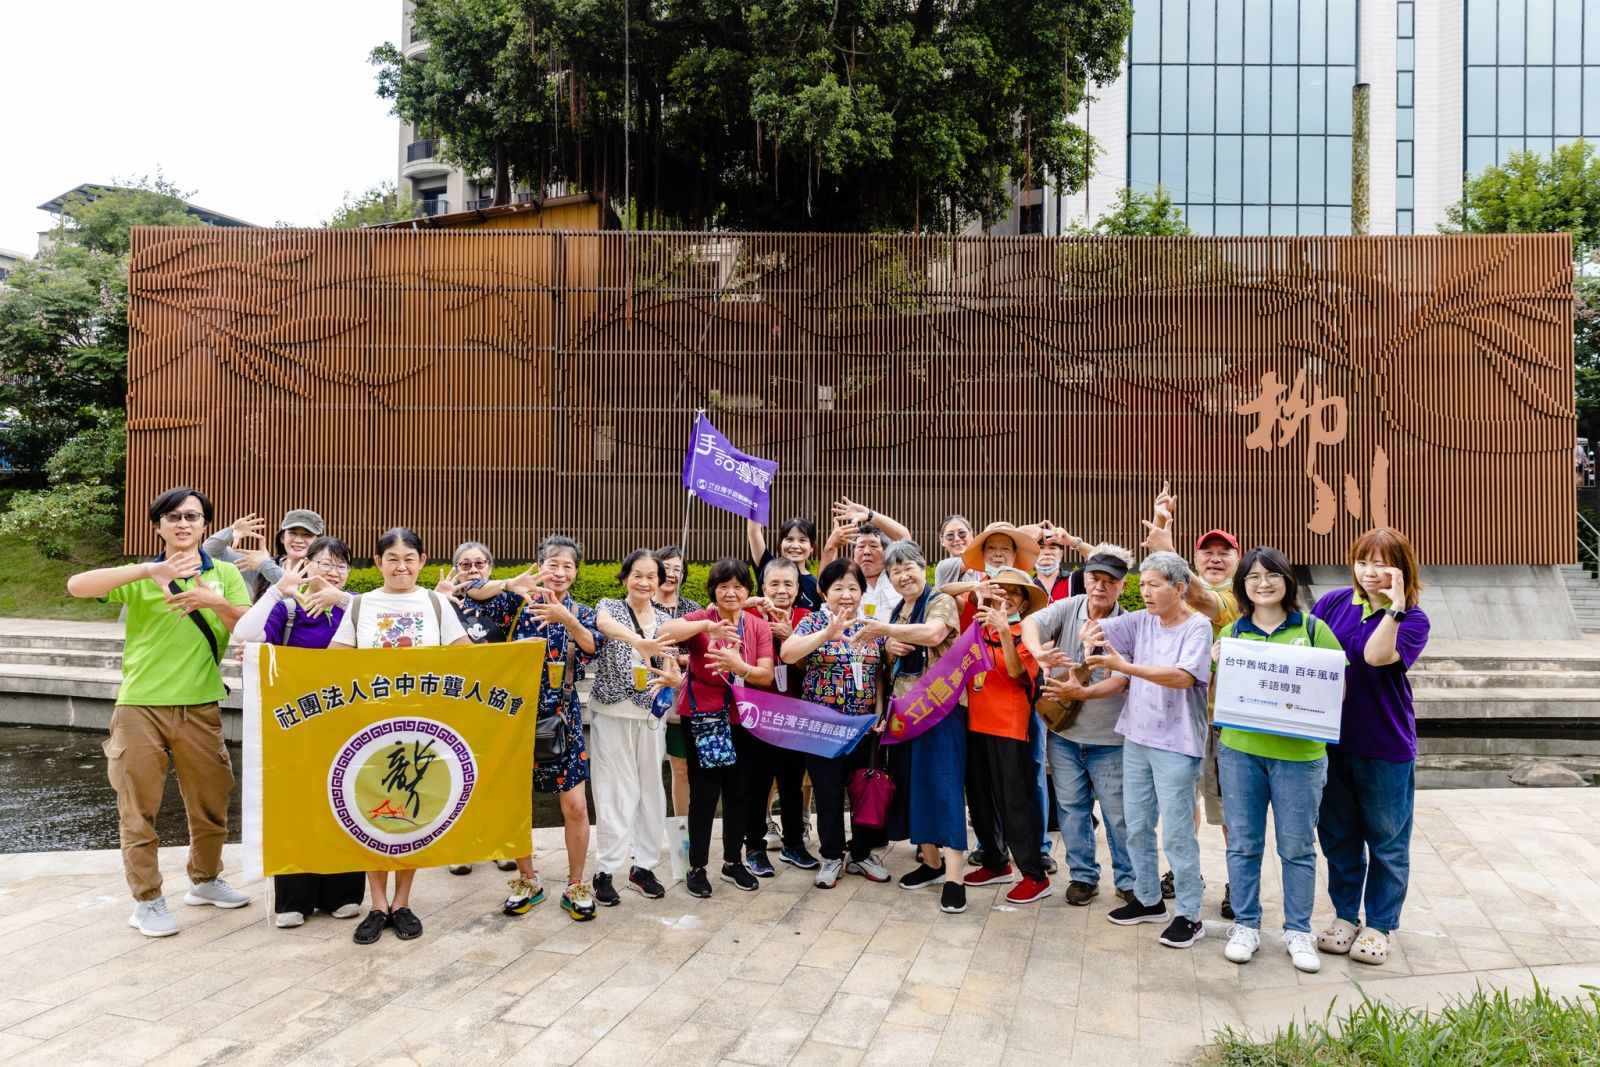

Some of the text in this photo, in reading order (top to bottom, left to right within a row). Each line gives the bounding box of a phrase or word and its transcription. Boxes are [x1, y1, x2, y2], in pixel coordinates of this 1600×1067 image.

[1237, 368, 1389, 536] 柳川
[1225, 656, 1340, 682] 台中舊城走讀 百年風華
[1258, 679, 1301, 695] 手語導覽
[274, 673, 524, 729] 社團法人台中市聾人協會
